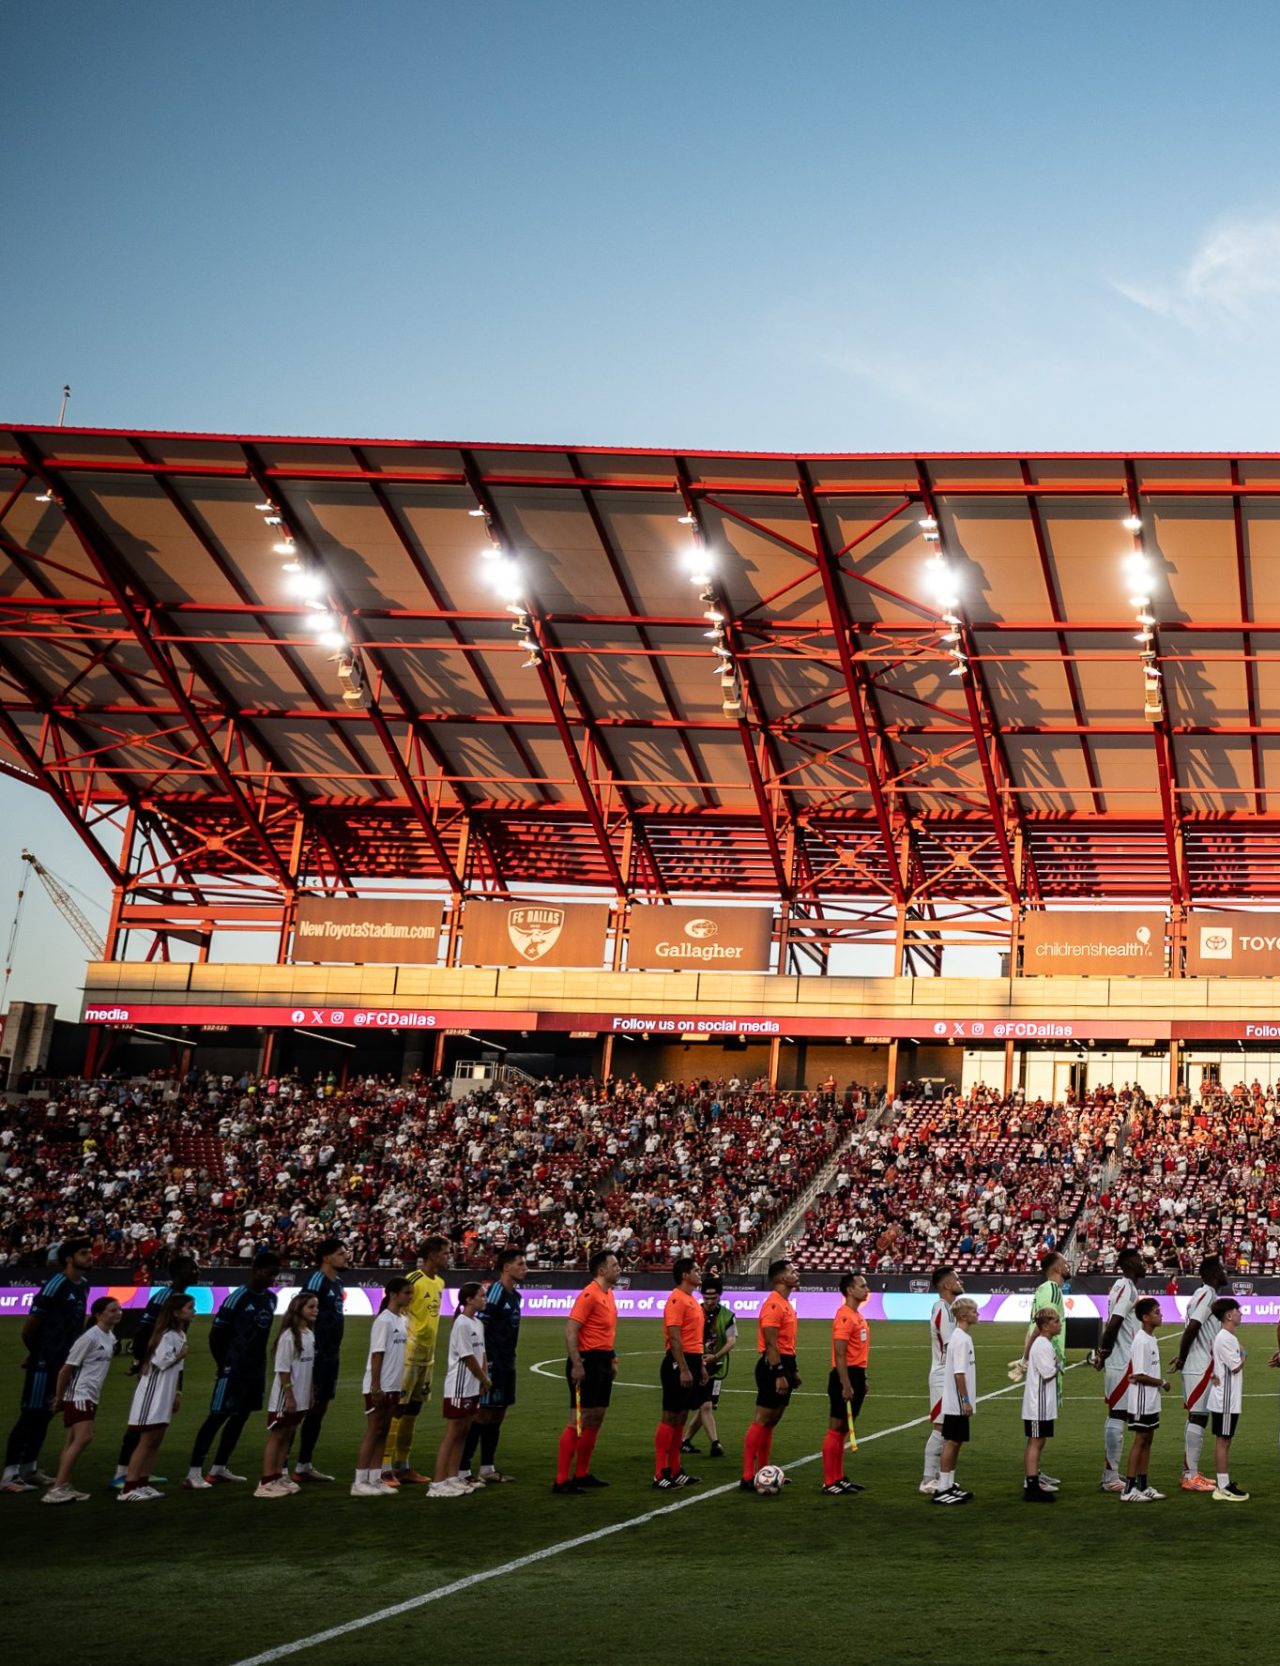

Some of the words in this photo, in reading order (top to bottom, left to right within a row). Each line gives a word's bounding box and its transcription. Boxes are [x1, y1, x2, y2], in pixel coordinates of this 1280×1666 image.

[512, 911, 525, 924] FC
[527, 911, 561, 926] DALLAS
[299, 920, 435, 940] NewToyotaStadium.com
[655, 942, 744, 960] Gallagher
[84, 1008, 129, 1021] media
[353, 1013, 436, 1026] @FCDallas
[612, 1018, 656, 1031] Follow
[659, 1021, 674, 1031] us
[677, 1021, 694, 1031] on
[697, 1019, 736, 1032] social
[739, 1020, 780, 1033] media
[993, 1023, 1073, 1037] @FCDallas
[637, 1297, 654, 1310] of
[733, 1300, 760, 1310] our
